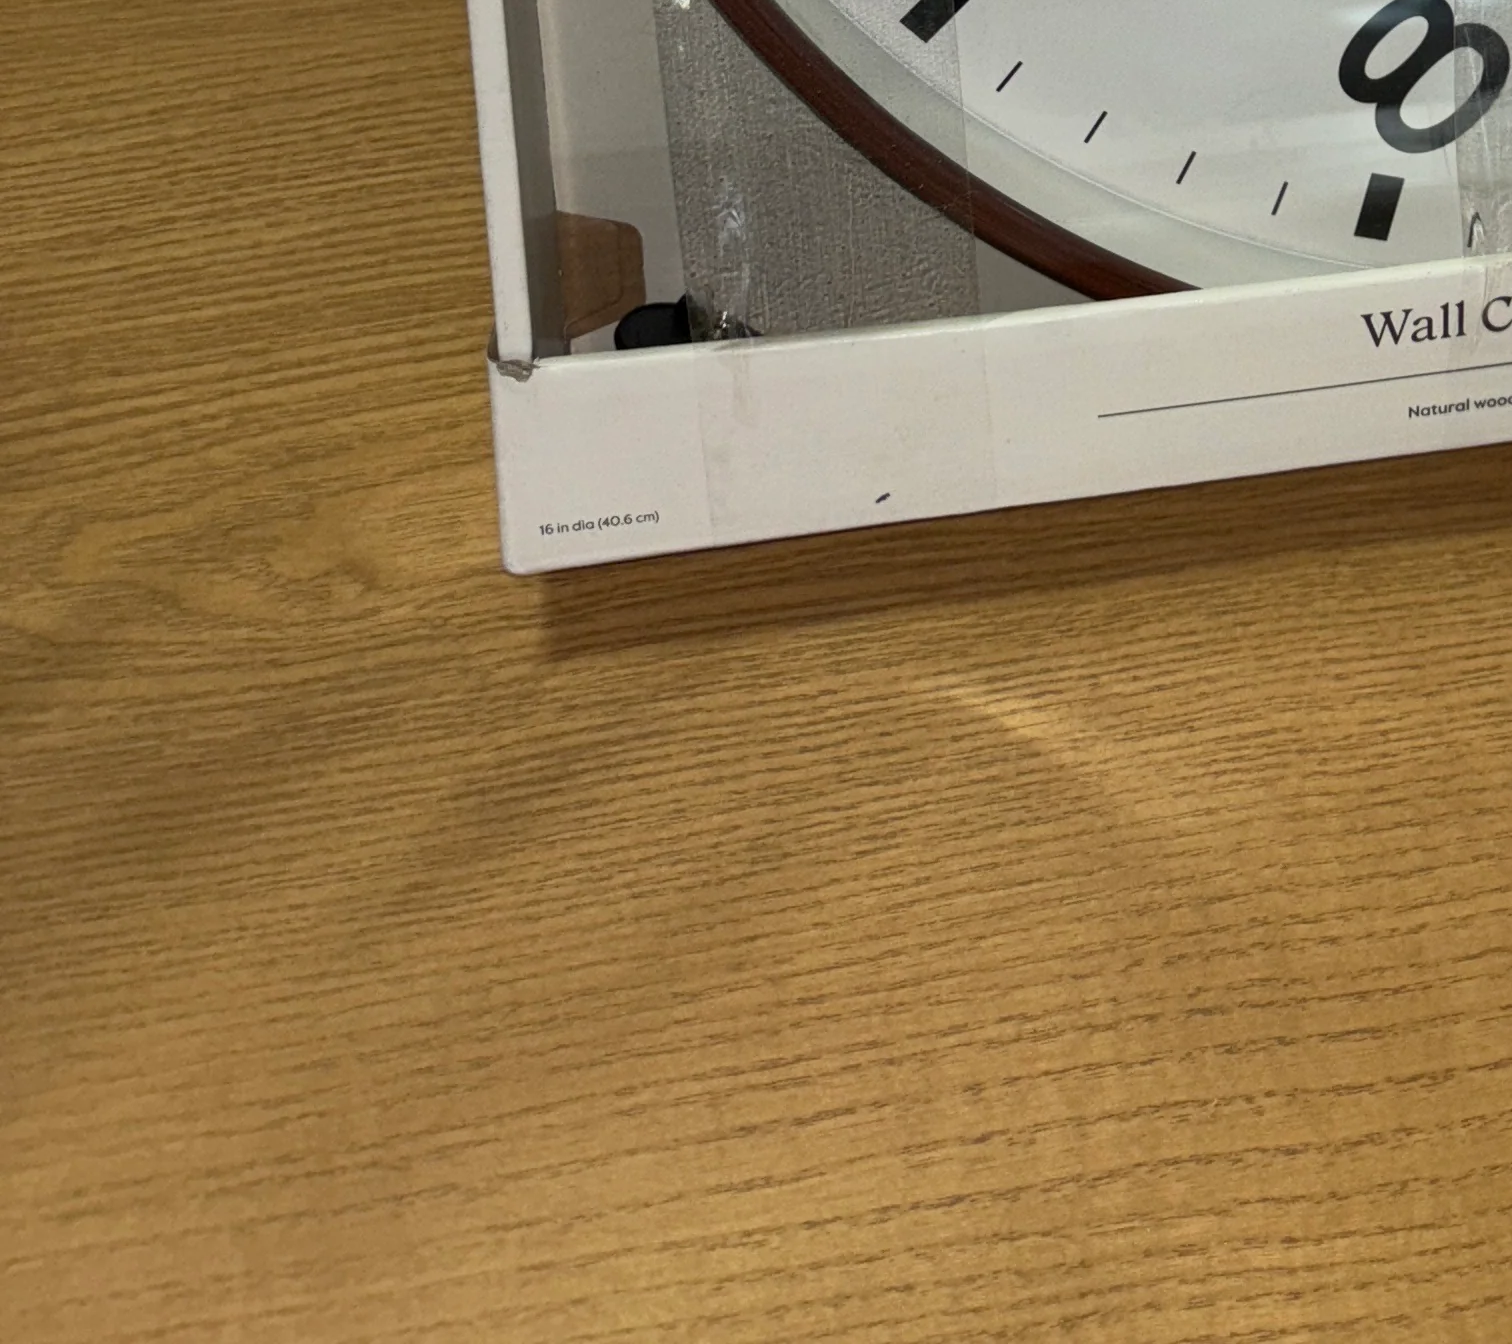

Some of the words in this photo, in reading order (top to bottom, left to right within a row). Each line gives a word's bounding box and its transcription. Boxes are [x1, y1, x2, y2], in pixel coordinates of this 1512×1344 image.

[1361, 300, 1467, 348] Wall
[1408, 398, 1470, 418] Natural
[539, 523, 555, 536] 16
[557, 522, 570, 534] in
[572, 519, 595, 532] dia
[598, 513, 633, 531] (40.6
[635, 510, 660, 524] cm)
